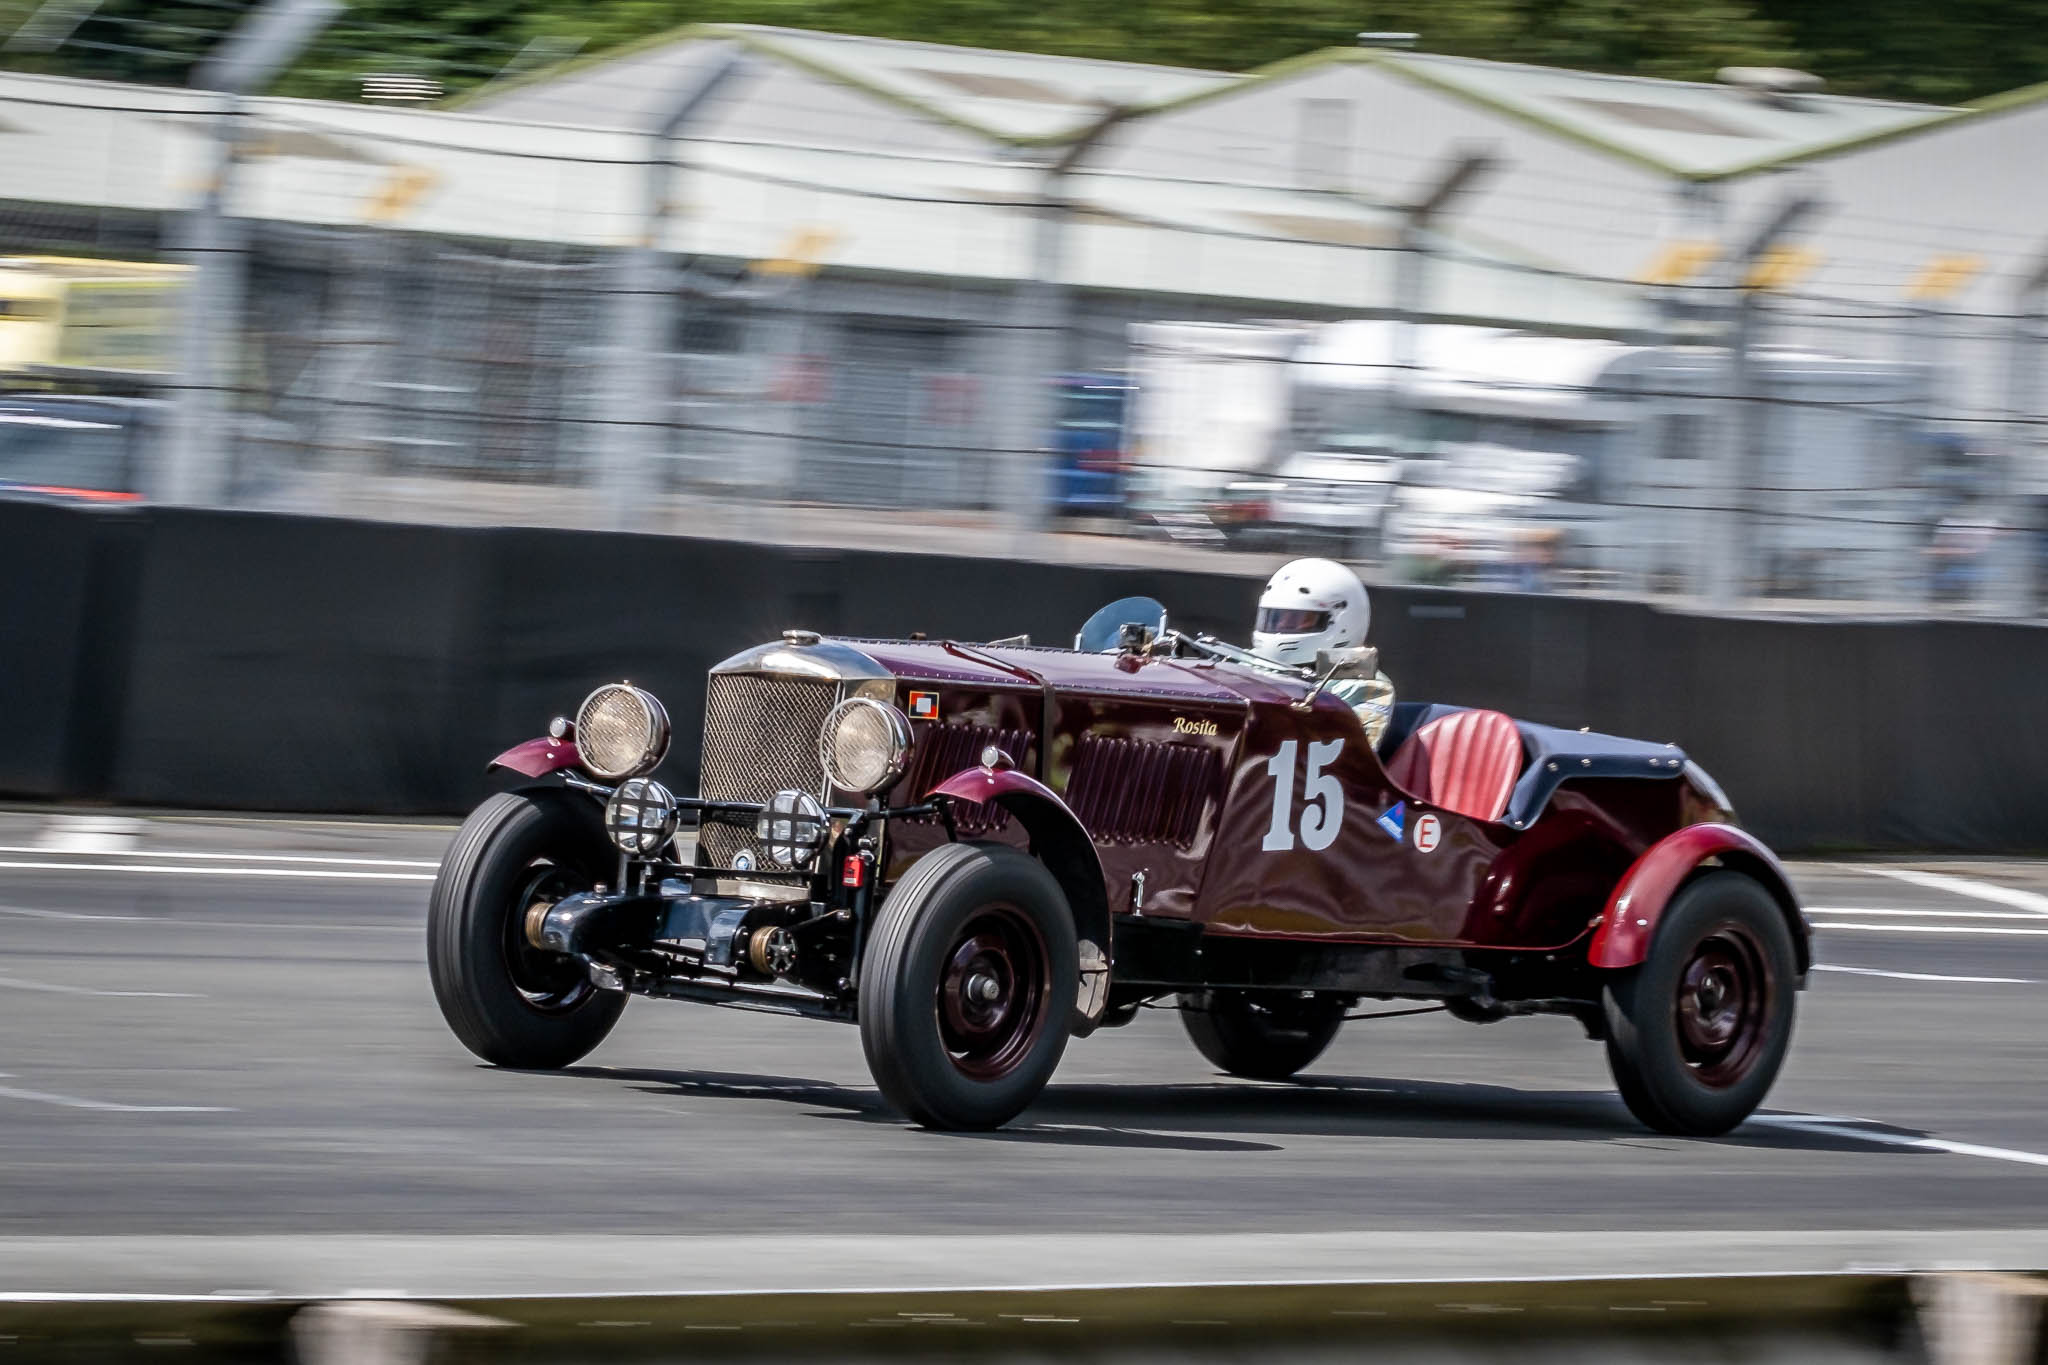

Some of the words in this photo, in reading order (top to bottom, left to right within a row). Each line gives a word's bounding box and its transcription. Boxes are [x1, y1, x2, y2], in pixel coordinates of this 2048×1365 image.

[1172, 717, 1217, 736] Rosita
[1262, 738, 1344, 851] 15
[1419, 819, 1436, 848] E
